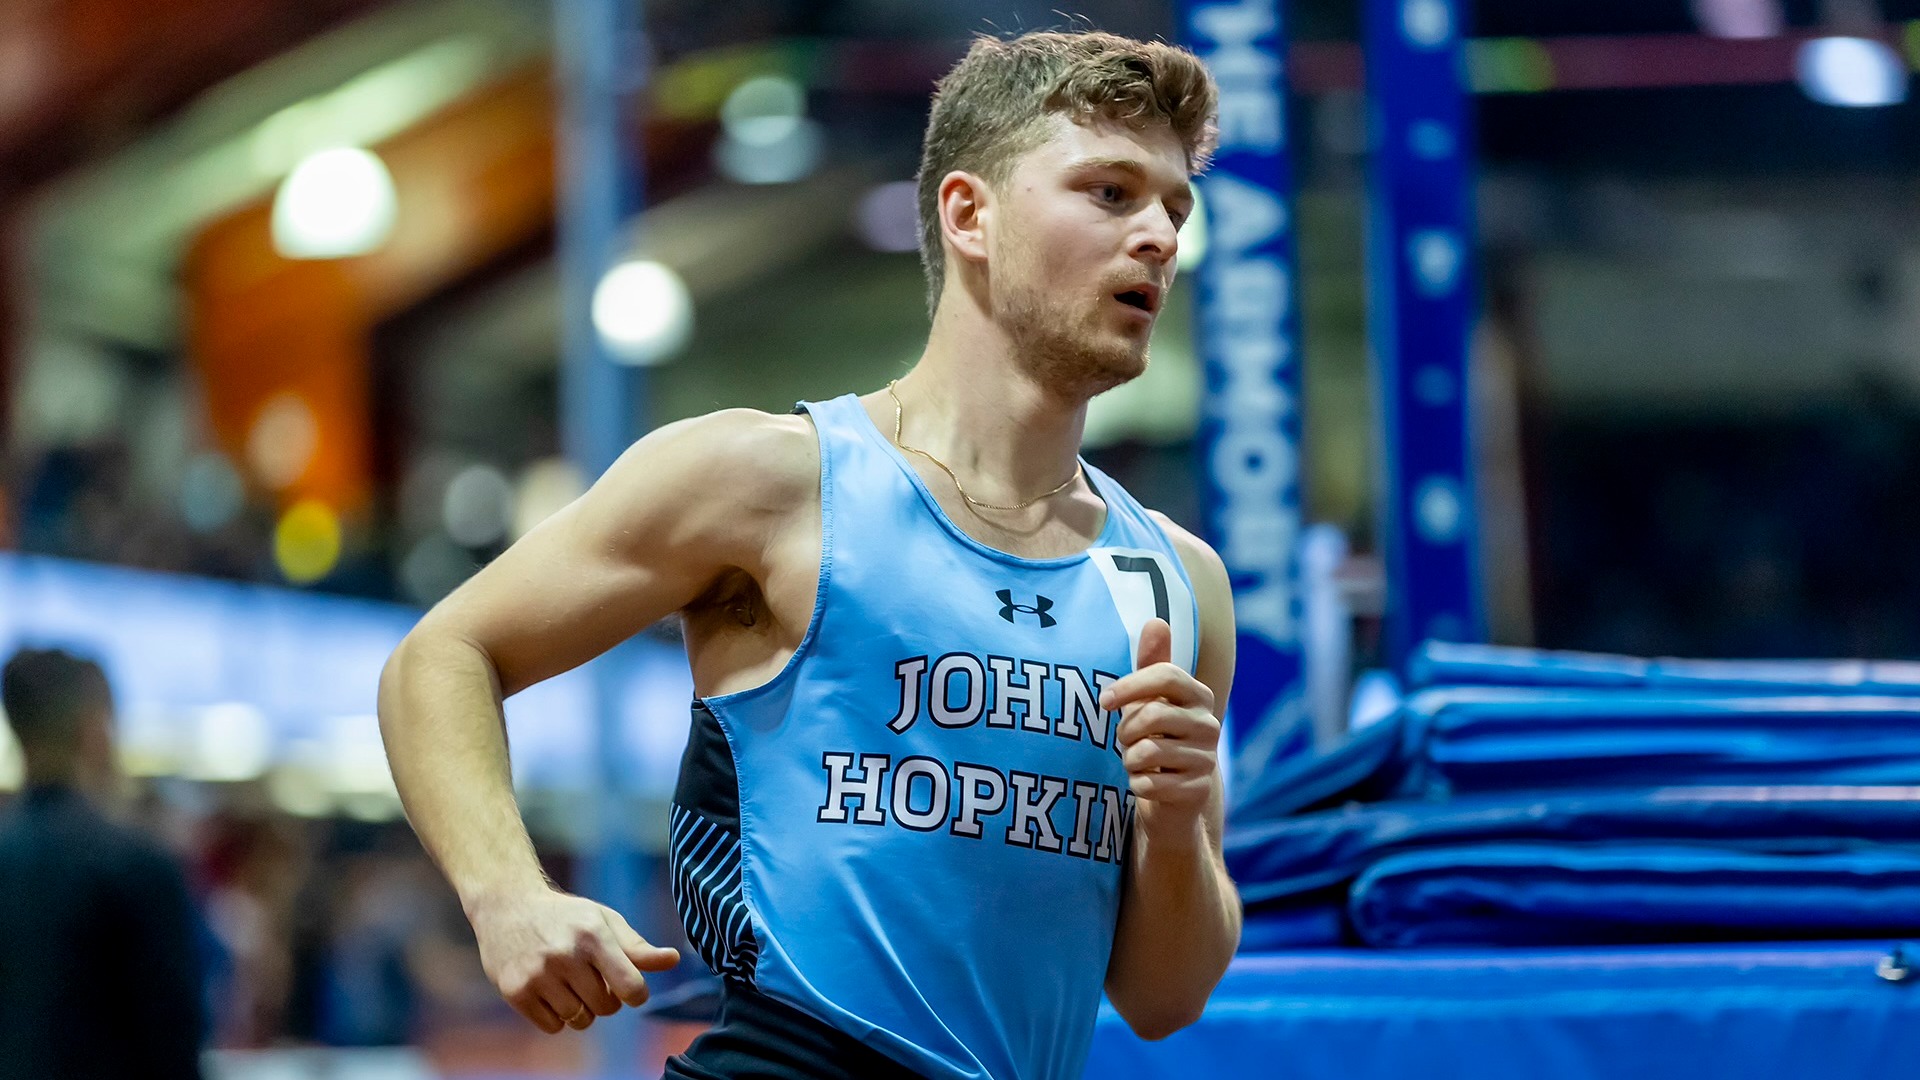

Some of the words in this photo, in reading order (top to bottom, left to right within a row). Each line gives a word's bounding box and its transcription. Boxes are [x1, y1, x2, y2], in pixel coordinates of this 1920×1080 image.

[1192, 0, 1281, 149] HE
[1204, 170, 1298, 649] ARMORY
[1111, 554, 1171, 627] 7
[886, 651, 1124, 760] JOHN
[816, 752, 1137, 866] HOPKIN
